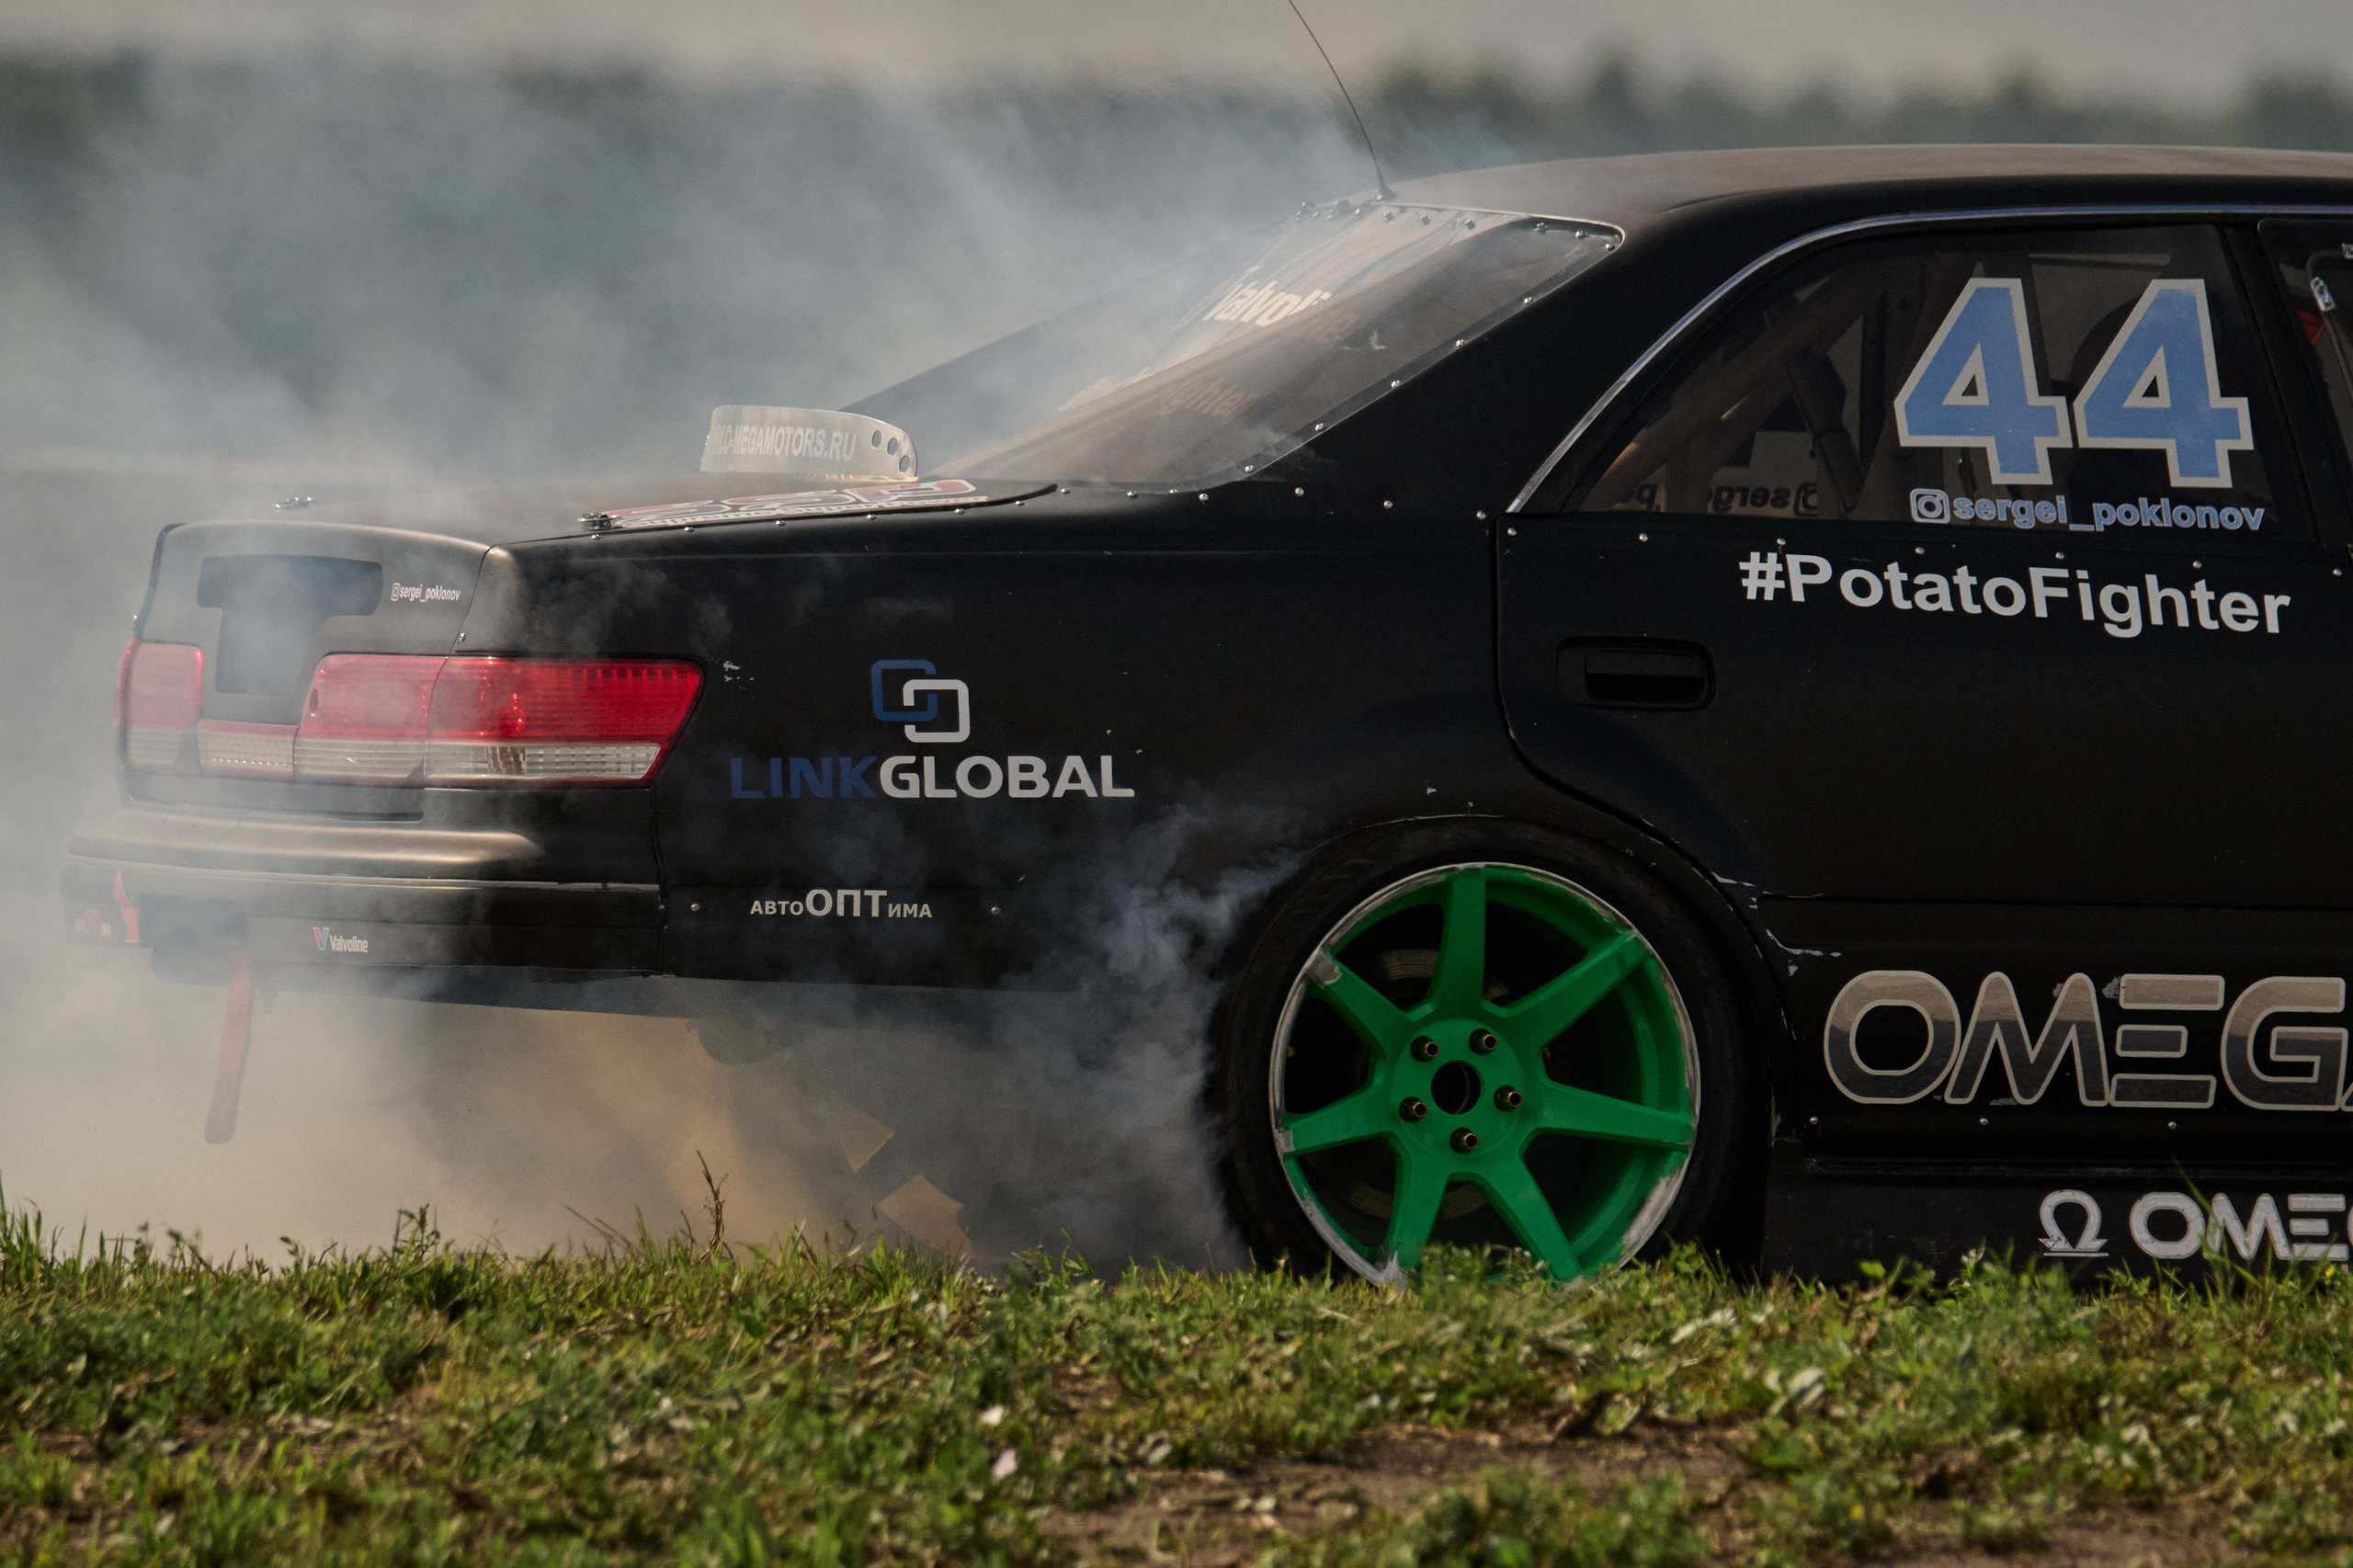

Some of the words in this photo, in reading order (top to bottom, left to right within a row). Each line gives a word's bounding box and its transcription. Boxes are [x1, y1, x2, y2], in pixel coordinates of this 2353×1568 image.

[1893, 278, 2254, 489] 44
[1739, 551, 2291, 639] #PotatoFighter
[329, 935, 369, 953] Valvoline
[1824, 970, 2353, 1112] OMEG
[2130, 1192, 2353, 1262] OME
